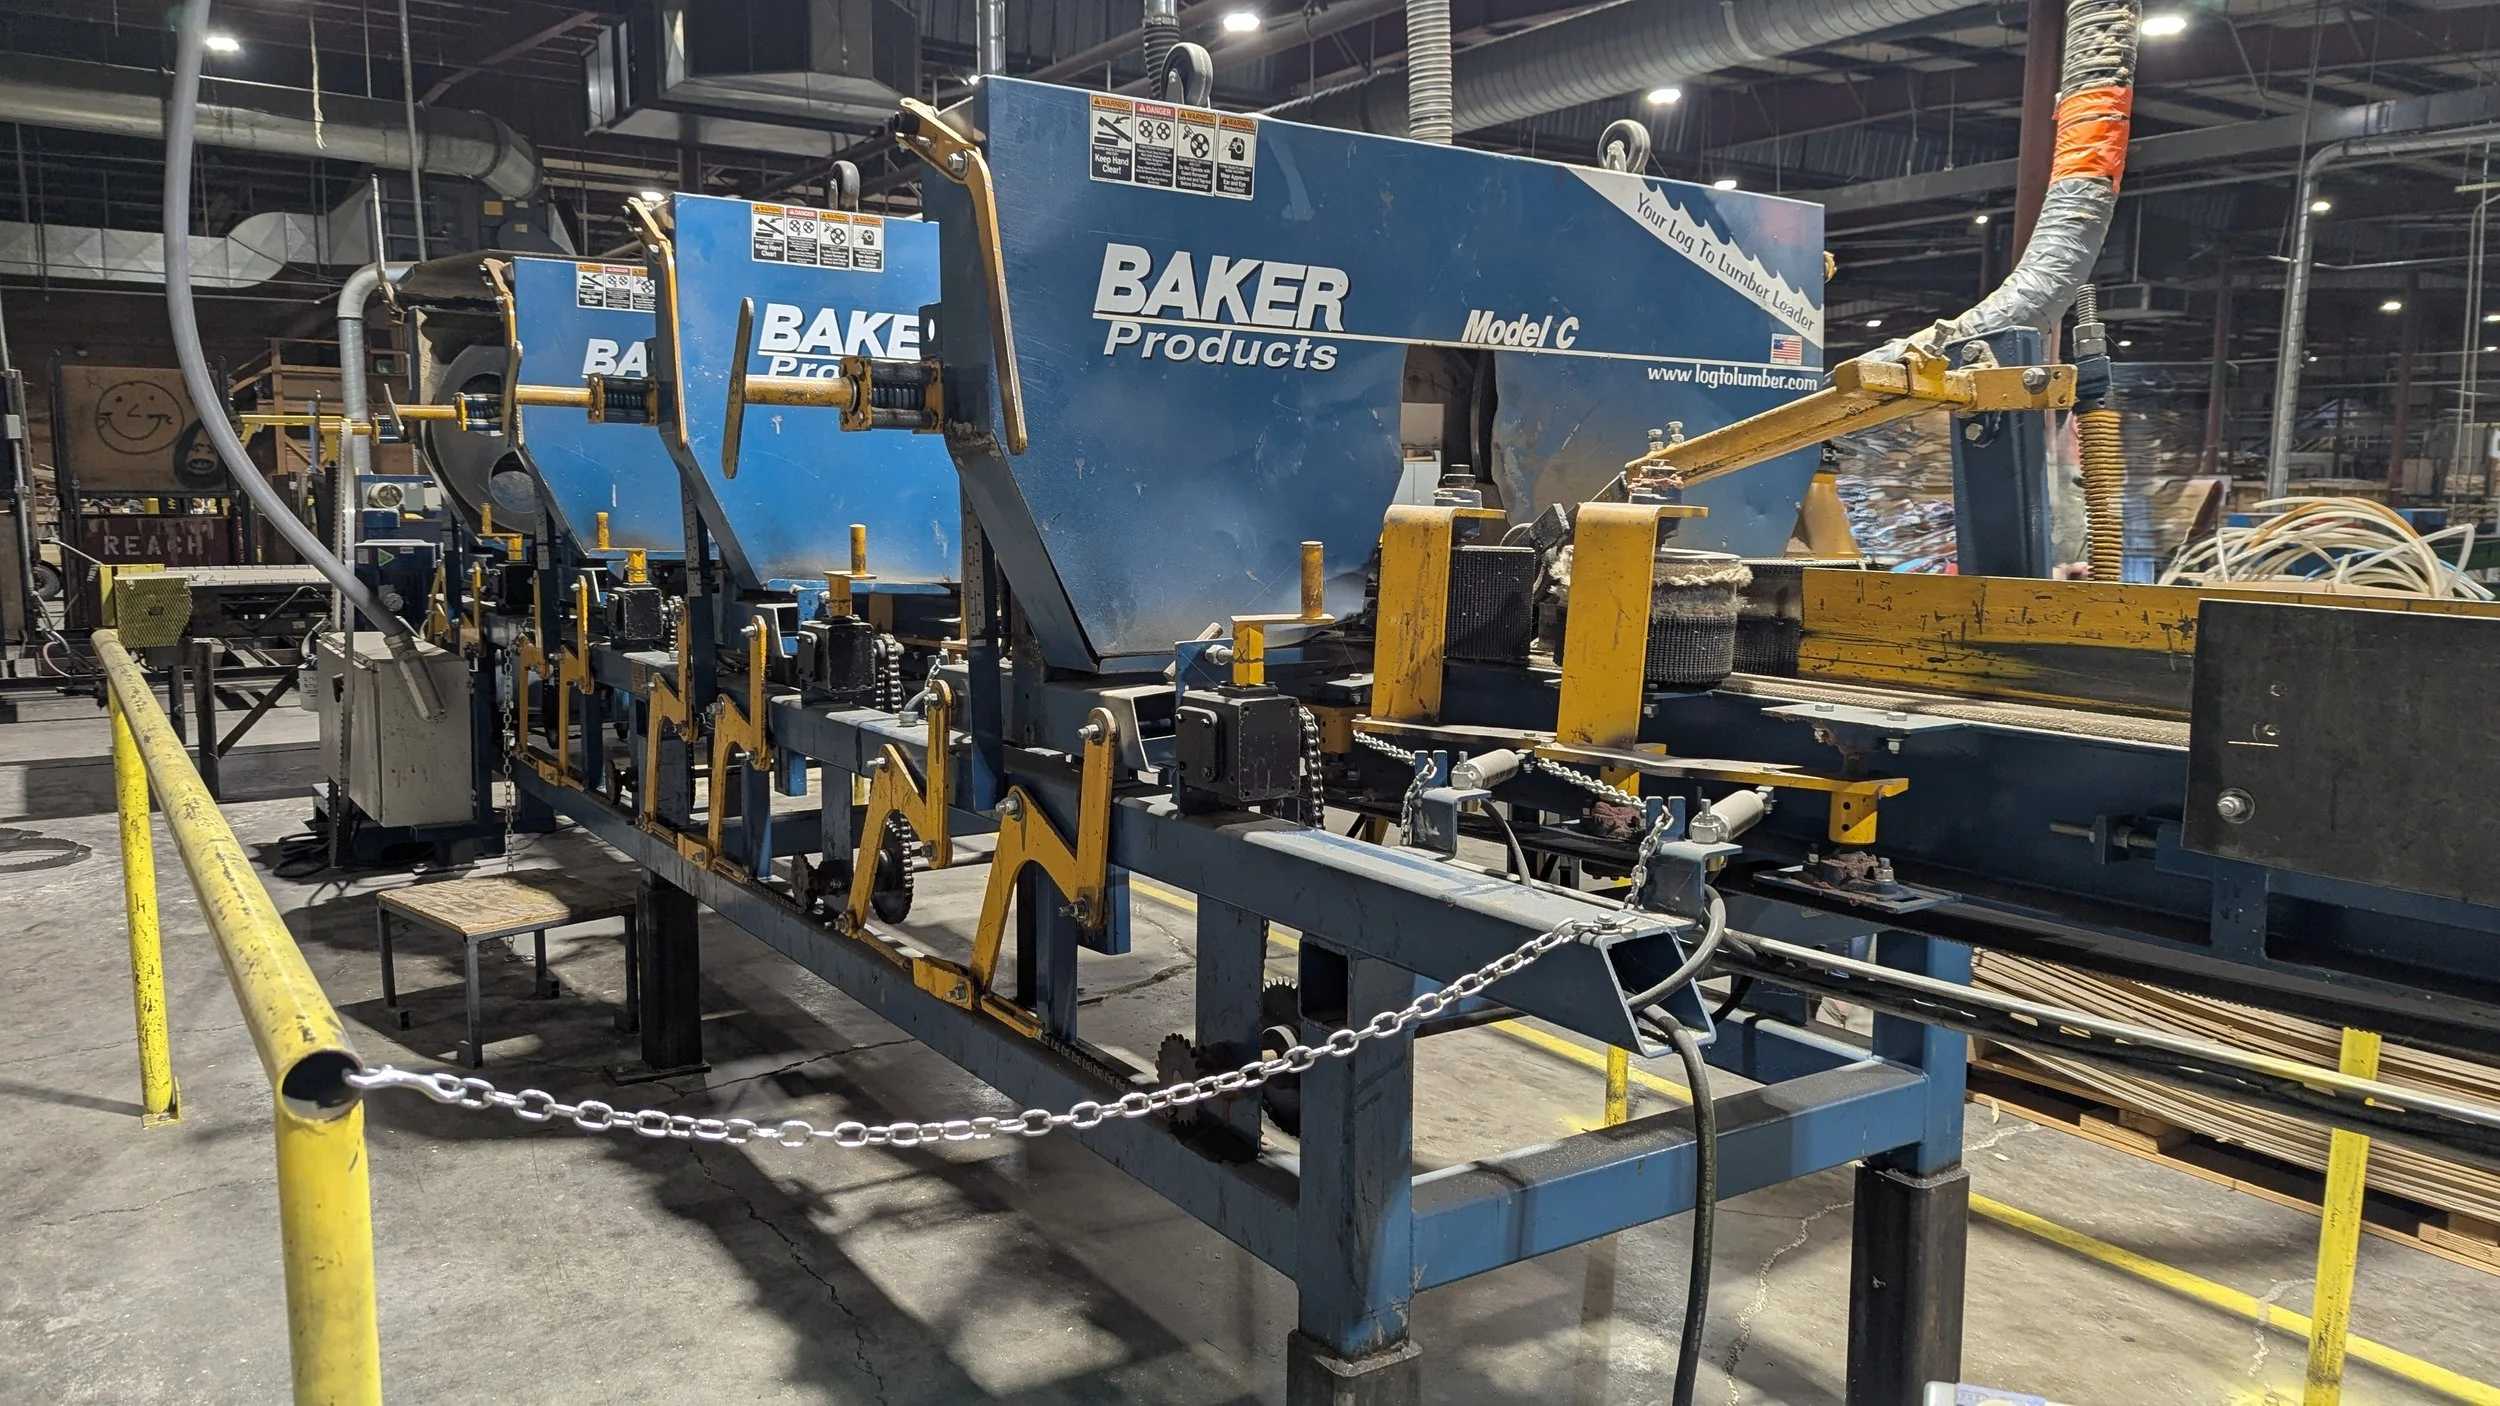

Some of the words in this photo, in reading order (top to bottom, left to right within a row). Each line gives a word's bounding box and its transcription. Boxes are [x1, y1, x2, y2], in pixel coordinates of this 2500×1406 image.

[1101, 98, 1130, 110] WARNING
[1146, 106, 1172, 117] DANGER
[1187, 111, 1214, 123] WARNING
[1228, 118, 1254, 130] WARNING
[1094, 153, 1112, 164] Keep
[1112, 156, 1130, 166] Hand
[1102, 164, 1122, 175] Clear!
[1636, 192, 1667, 230] Your
[1668, 219, 1695, 254] Log
[1700, 238, 1715, 264] To
[1717, 253, 1770, 300] Lumber
[1094, 243, 1351, 332] BAKER
[759, 303, 921, 358] BAKE
[1461, 309, 1549, 348] Model
[1555, 316, 1581, 348] C
[1104, 320, 1339, 371] Products
[103, 535, 204, 556] REACH
